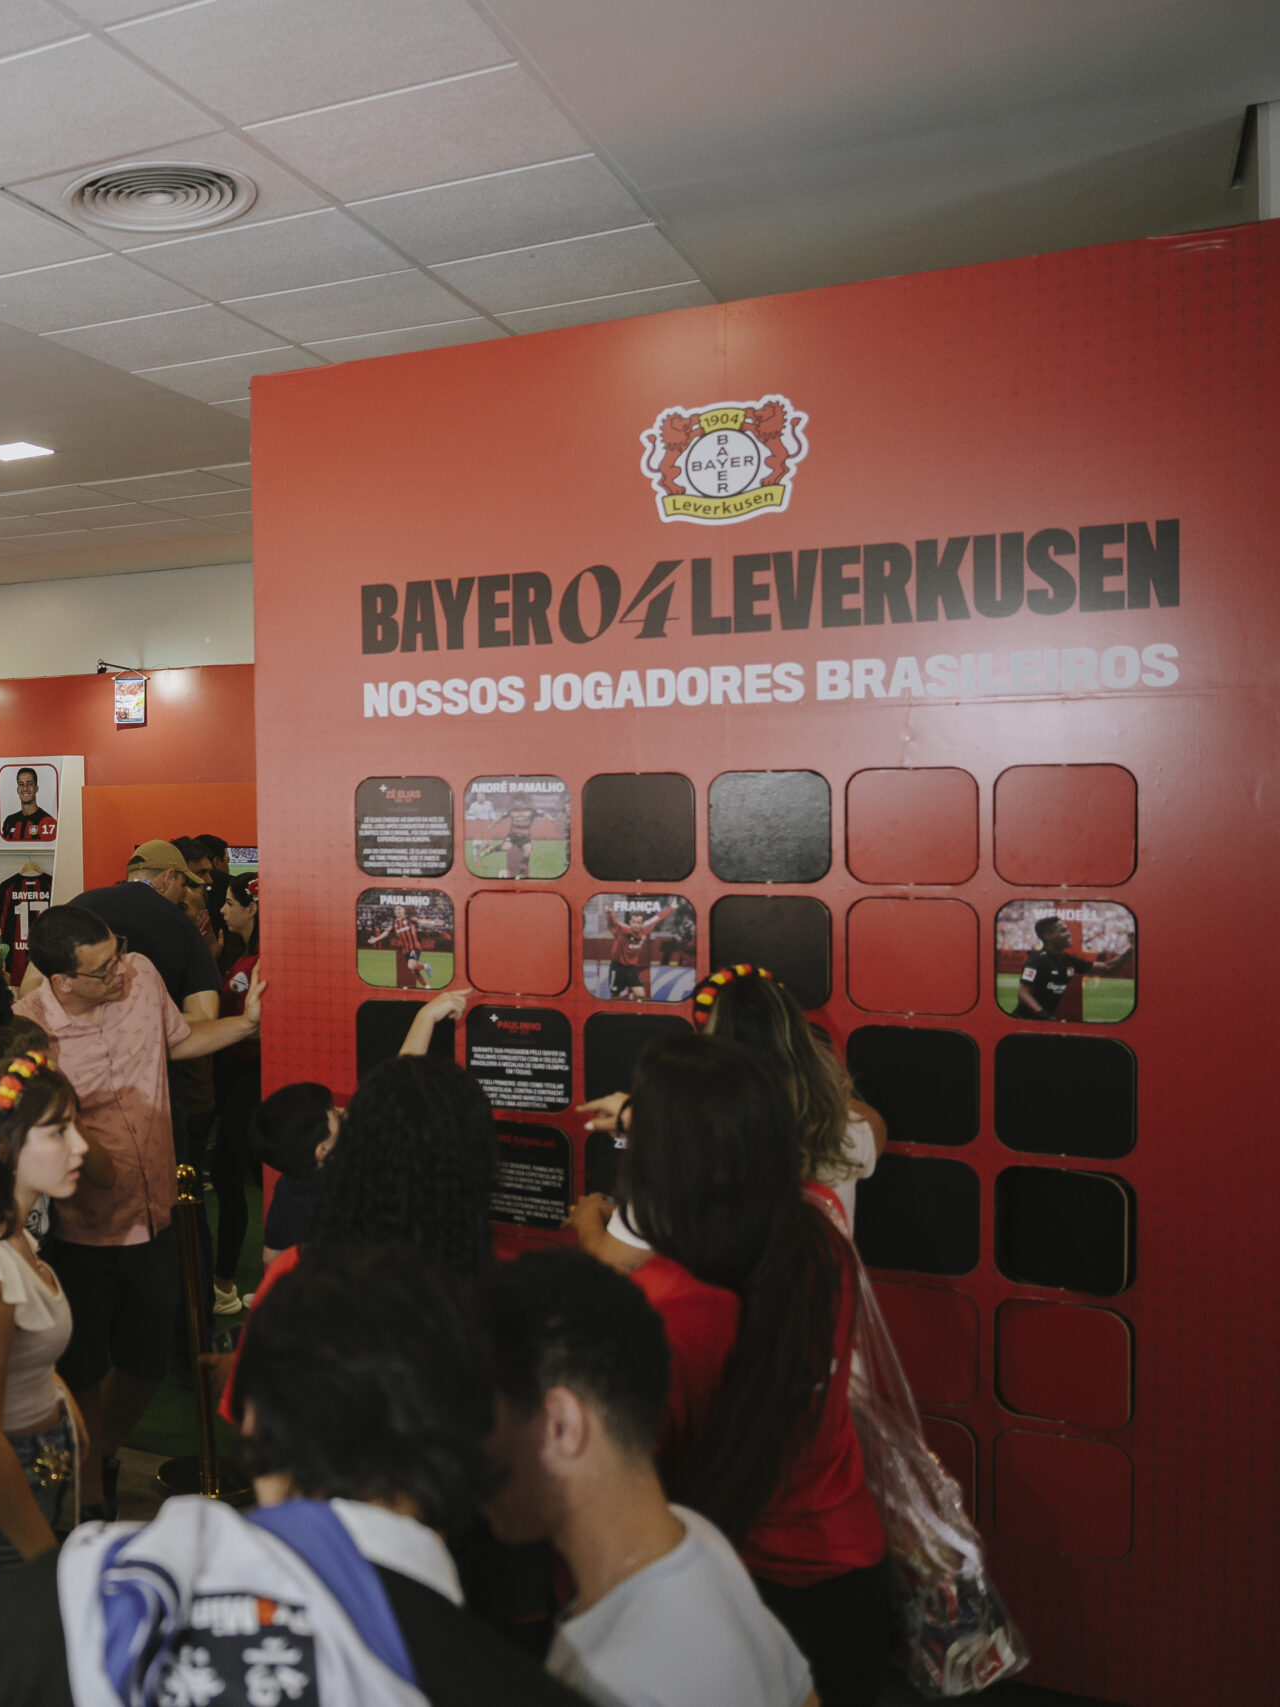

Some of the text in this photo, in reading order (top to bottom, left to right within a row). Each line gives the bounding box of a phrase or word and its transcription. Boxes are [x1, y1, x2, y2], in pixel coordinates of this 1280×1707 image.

[703, 413, 740, 428] 1904
[691, 455, 755, 472] BAYER
[716, 434, 729, 494] BAYER
[672, 491, 775, 515] Leverkusen
[361, 518, 1181, 655] BAYER 04 LEVERKUSEN
[362, 642, 1180, 718] NOSSOS JOGADORES BRASILEIROS
[470, 780, 566, 793] ANDRÉ RAMALHO
[41, 824, 56, 835] 17
[12, 891, 50, 900] BAYER 04
[379, 894, 430, 906] PAULINHO
[613, 900, 662, 914] FRANÇA
[1033, 908, 1098, 920] WENDELL
[497, 1021, 542, 1031] PAULINHO
